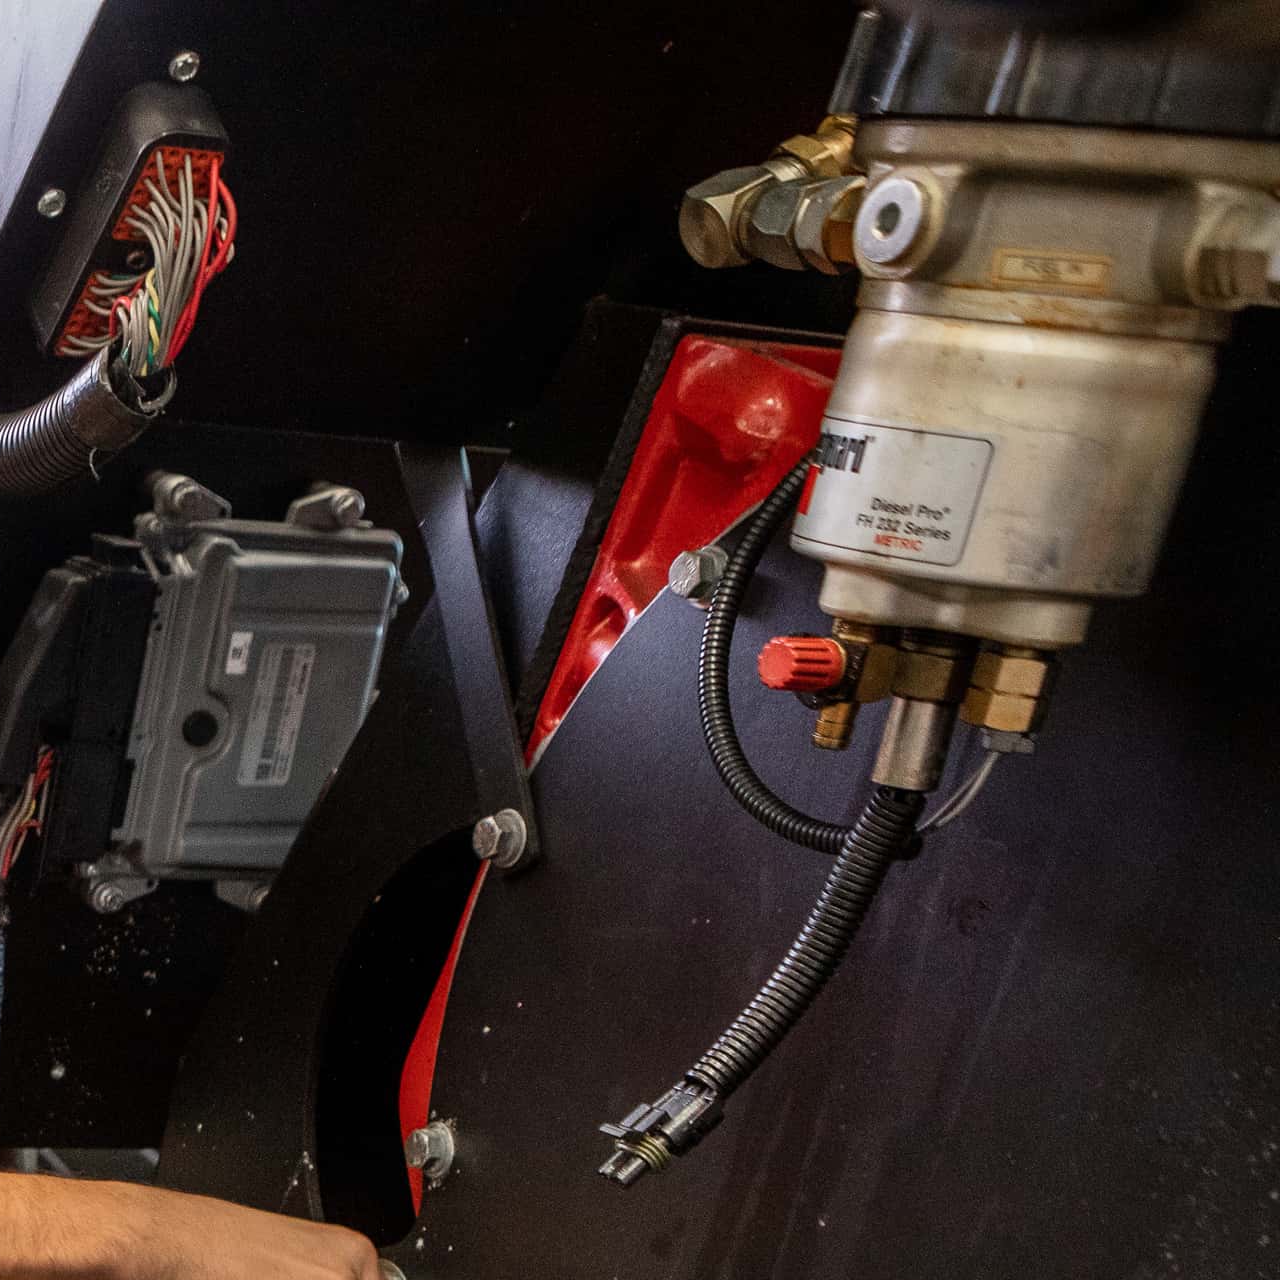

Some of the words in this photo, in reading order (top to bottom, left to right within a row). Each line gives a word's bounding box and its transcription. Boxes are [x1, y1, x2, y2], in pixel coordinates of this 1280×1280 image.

[871, 497, 914, 515] Diesel
[856, 513, 875, 528] FH
[876, 516, 901, 532] 232
[904, 521, 952, 541] Series
[873, 533, 924, 551] METRIC
